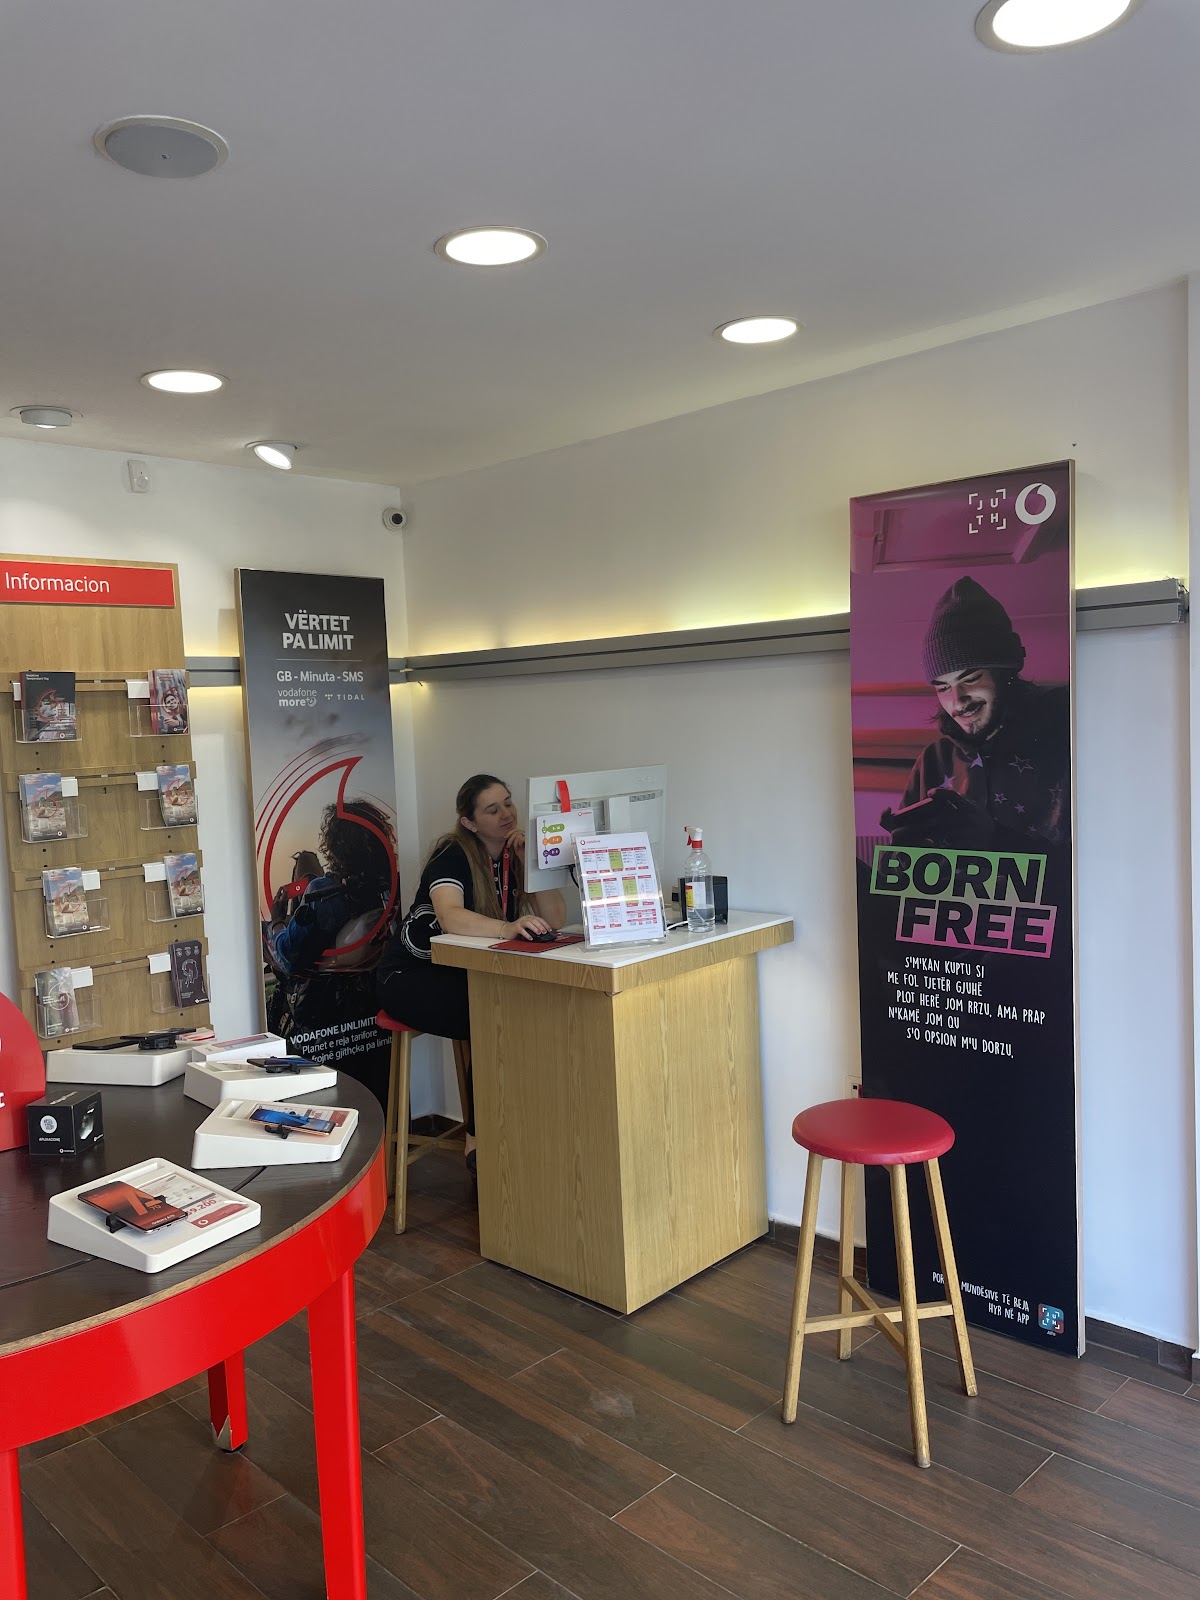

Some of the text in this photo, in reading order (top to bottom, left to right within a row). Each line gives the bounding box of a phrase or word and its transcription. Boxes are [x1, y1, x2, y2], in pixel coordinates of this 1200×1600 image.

[5, 572, 110, 593] Informacion
[284, 609, 351, 632] VËRTET
[282, 633, 354, 650] PA LIMIT
[276, 670, 293, 682] GB
[300, 671, 335, 682] Minuta
[342, 671, 364, 682] SMS
[277, 688, 317, 697] vodafone
[875, 850, 1042, 904] BORN
[901, 897, 1052, 954] FREE
[944, 961, 971, 976] KUPTU
[976, 965, 985, 978] SI
[887, 971, 983, 997] ME FOL TJETËR GJUHË
[888, 1006, 960, 1029] N'KAMË JOM QU
[896, 989, 915, 1004] PLOT
[919, 993, 940, 1009] HERË
[945, 998, 964, 1012] JOM
[997, 1004, 1018, 1021] AMA
[1022, 1008, 1046, 1026] PRAP
[290, 1016, 377, 1045] VODAFONE UNLIMIT
[302, 1029, 378, 1055] Planet e reja tarifore
[906, 1027, 921, 1041] S'O
[924, 1029, 957, 1048] OPSION
[961, 1036, 978, 1050] M'U
[366, 1041, 376, 1053] pa
[960, 1280, 999, 1302] MUNDËSIVE
[1001, 1293, 1011, 1306] TË
[1013, 1296, 1030, 1313] REJA
[988, 1302, 1002, 1316] HYR
[1017, 1314, 1030, 1325] APP
